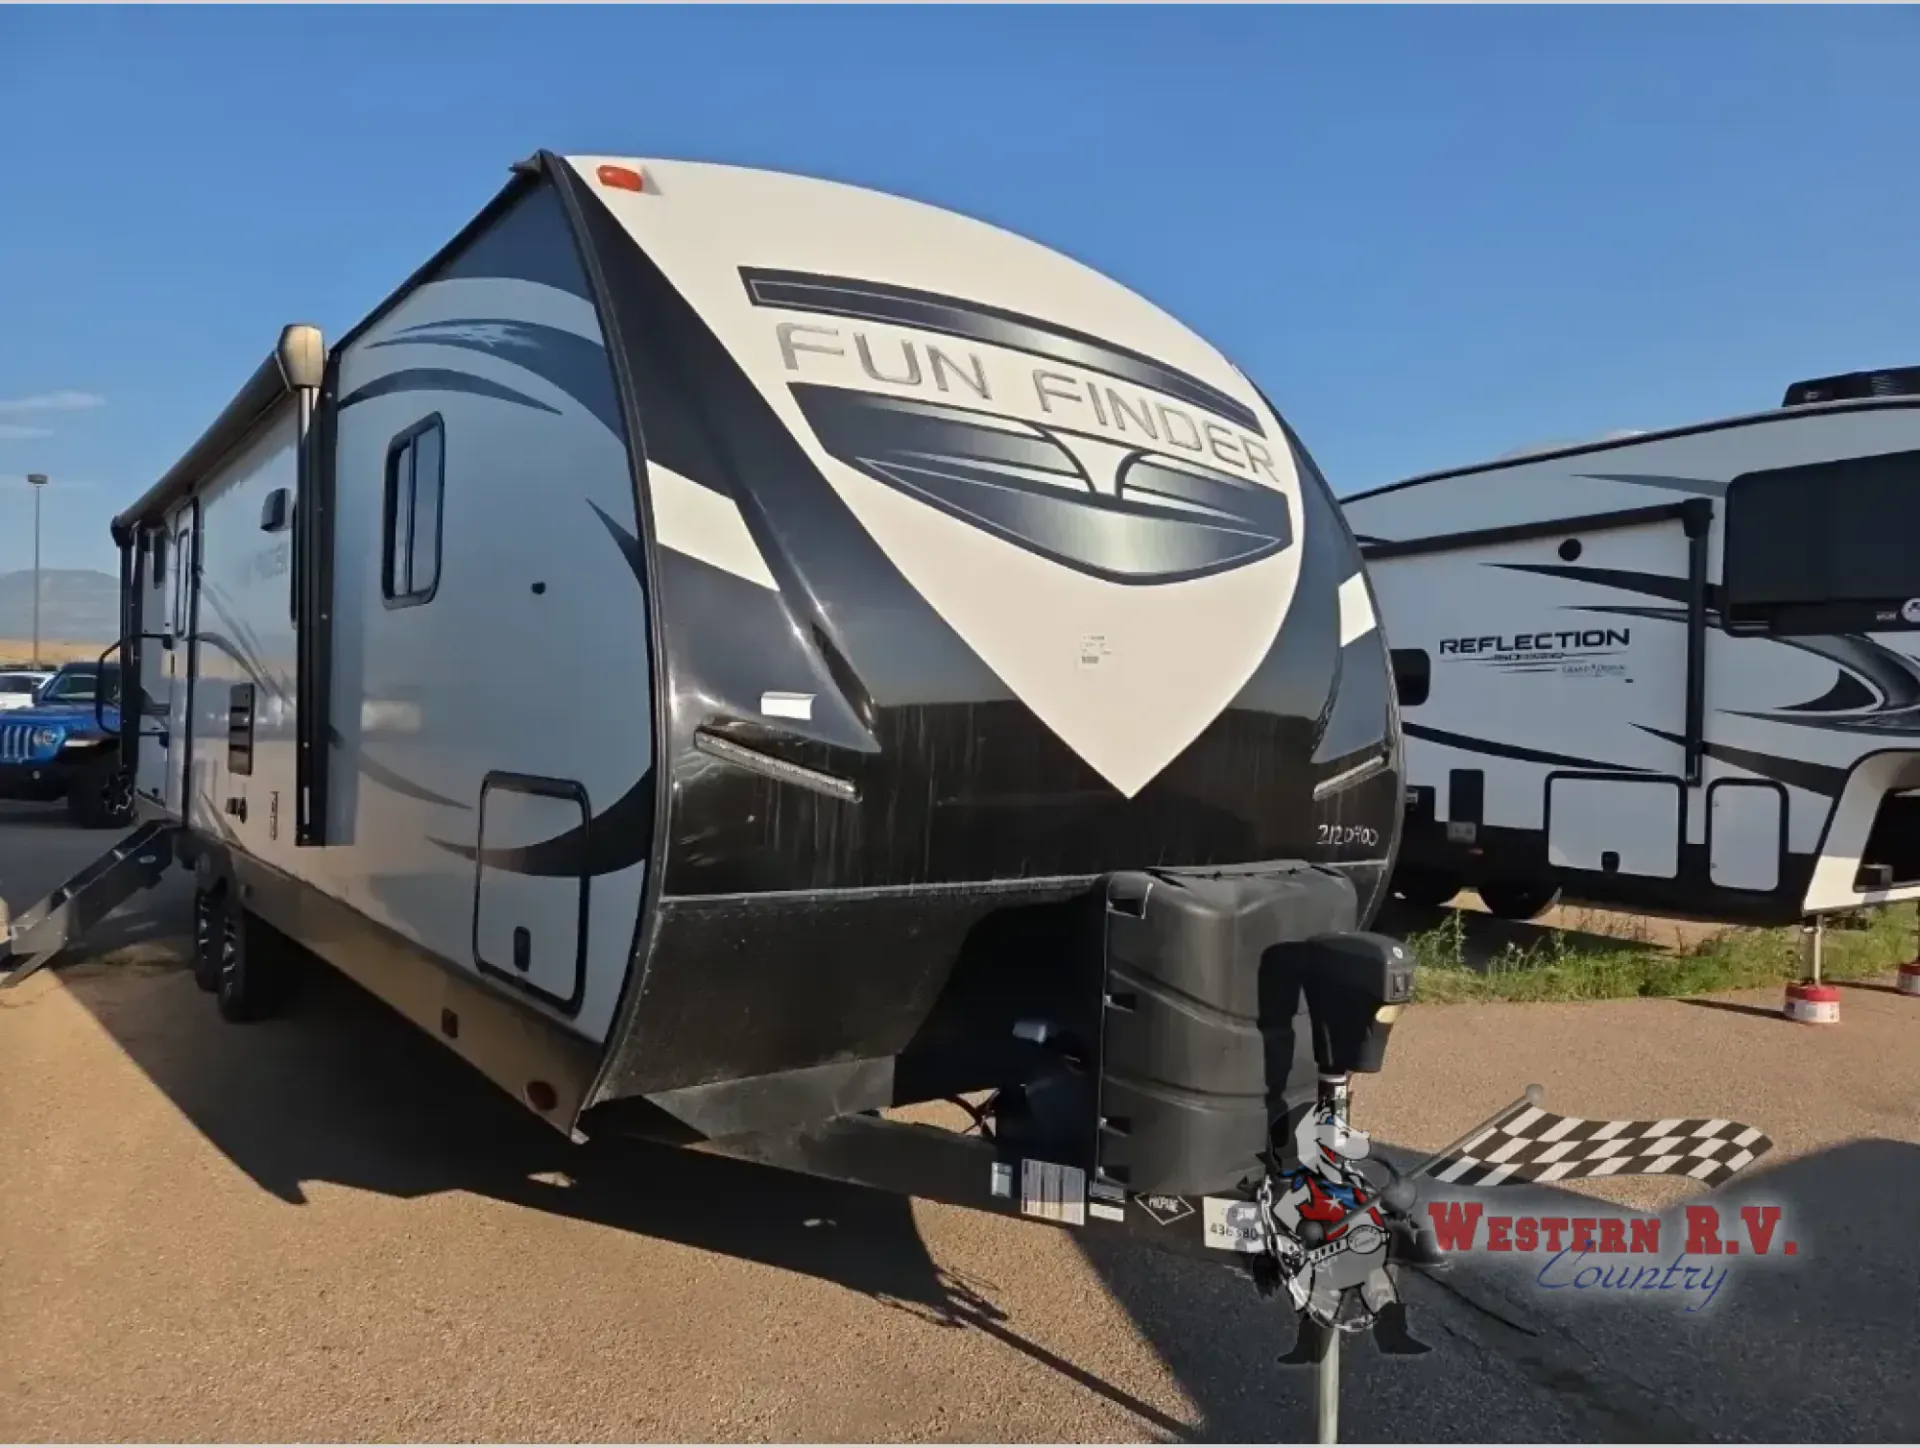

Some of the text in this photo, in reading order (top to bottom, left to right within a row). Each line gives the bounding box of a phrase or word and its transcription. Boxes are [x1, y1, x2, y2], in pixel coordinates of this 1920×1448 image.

[776, 322, 1280, 482] FUN FINDER
[1439, 627, 1630, 655] REFLECTION
